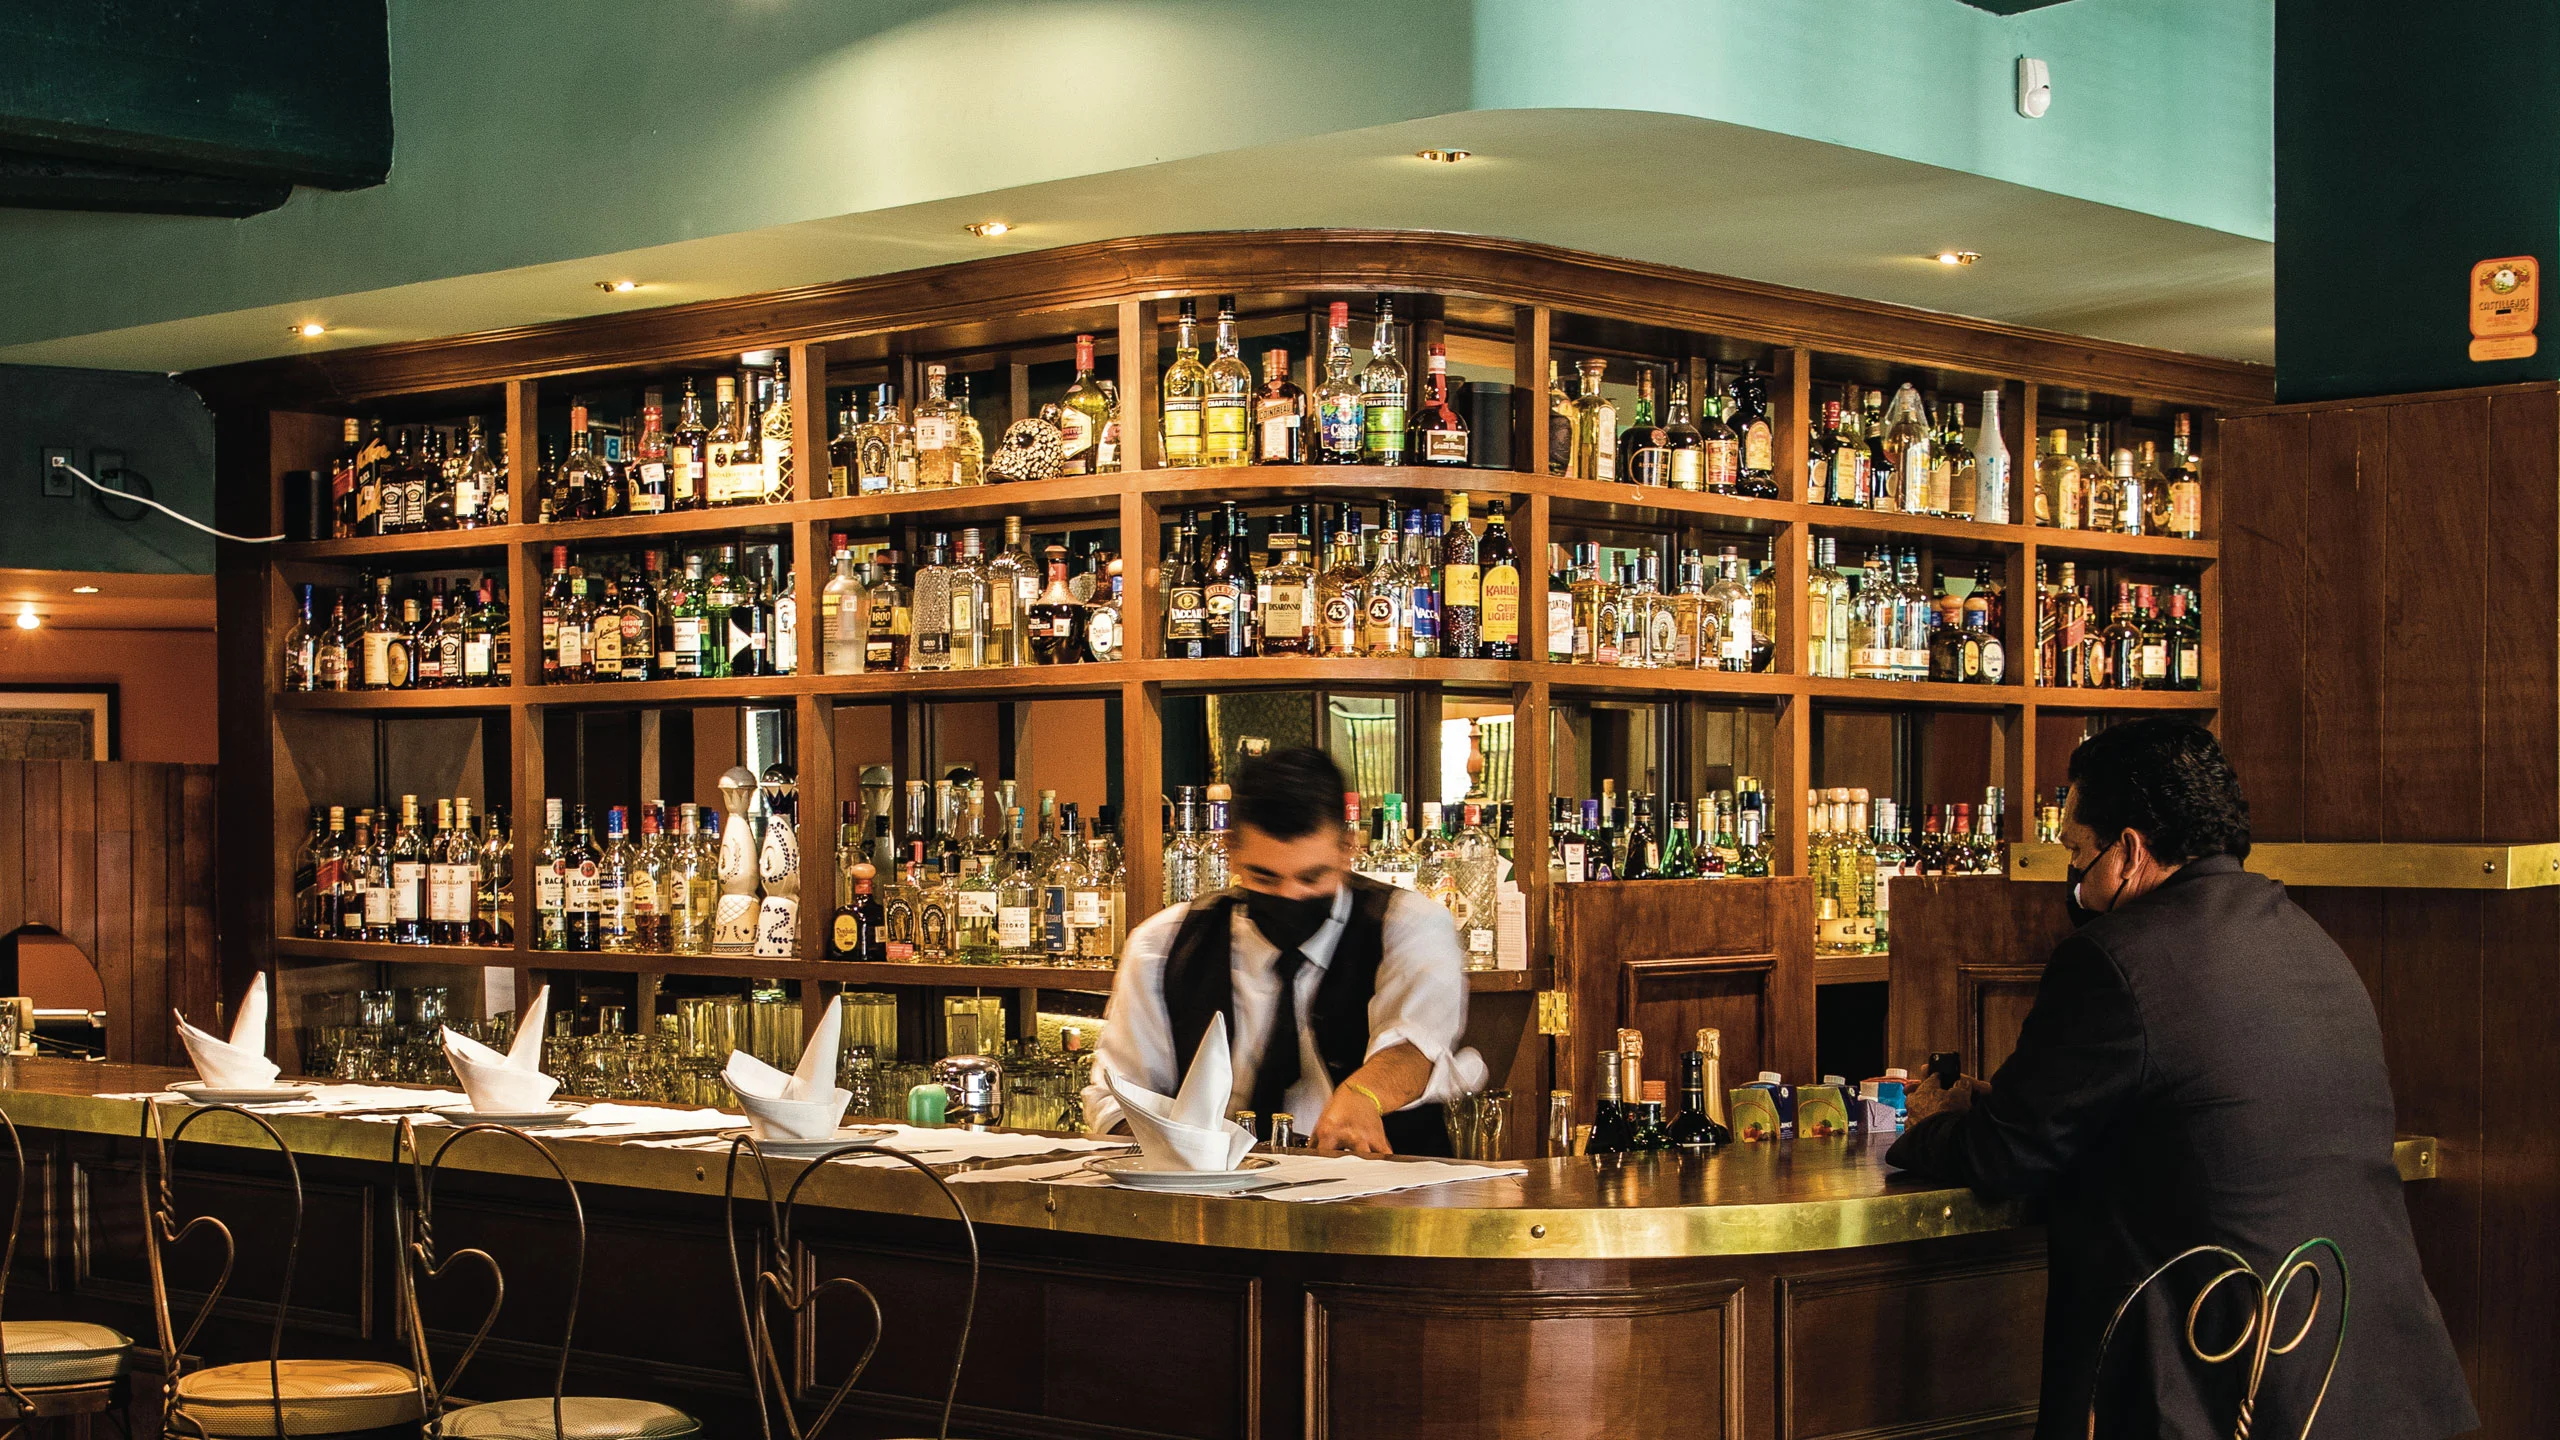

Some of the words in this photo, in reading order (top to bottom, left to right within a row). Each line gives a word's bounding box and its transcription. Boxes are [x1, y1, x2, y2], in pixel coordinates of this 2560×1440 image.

[1208, 399, 1246, 407] CHARTREUSE
[1260, 403, 1291, 419] COINTREAU
[1268, 603, 1301, 611] DISARONNO
[1328, 604, 1347, 619] 43
[1371, 602, 1389, 618] 43
[871, 611, 891, 622] 1800
[545, 877, 564, 885] BACA
[1046, 893, 1053, 909] 7
